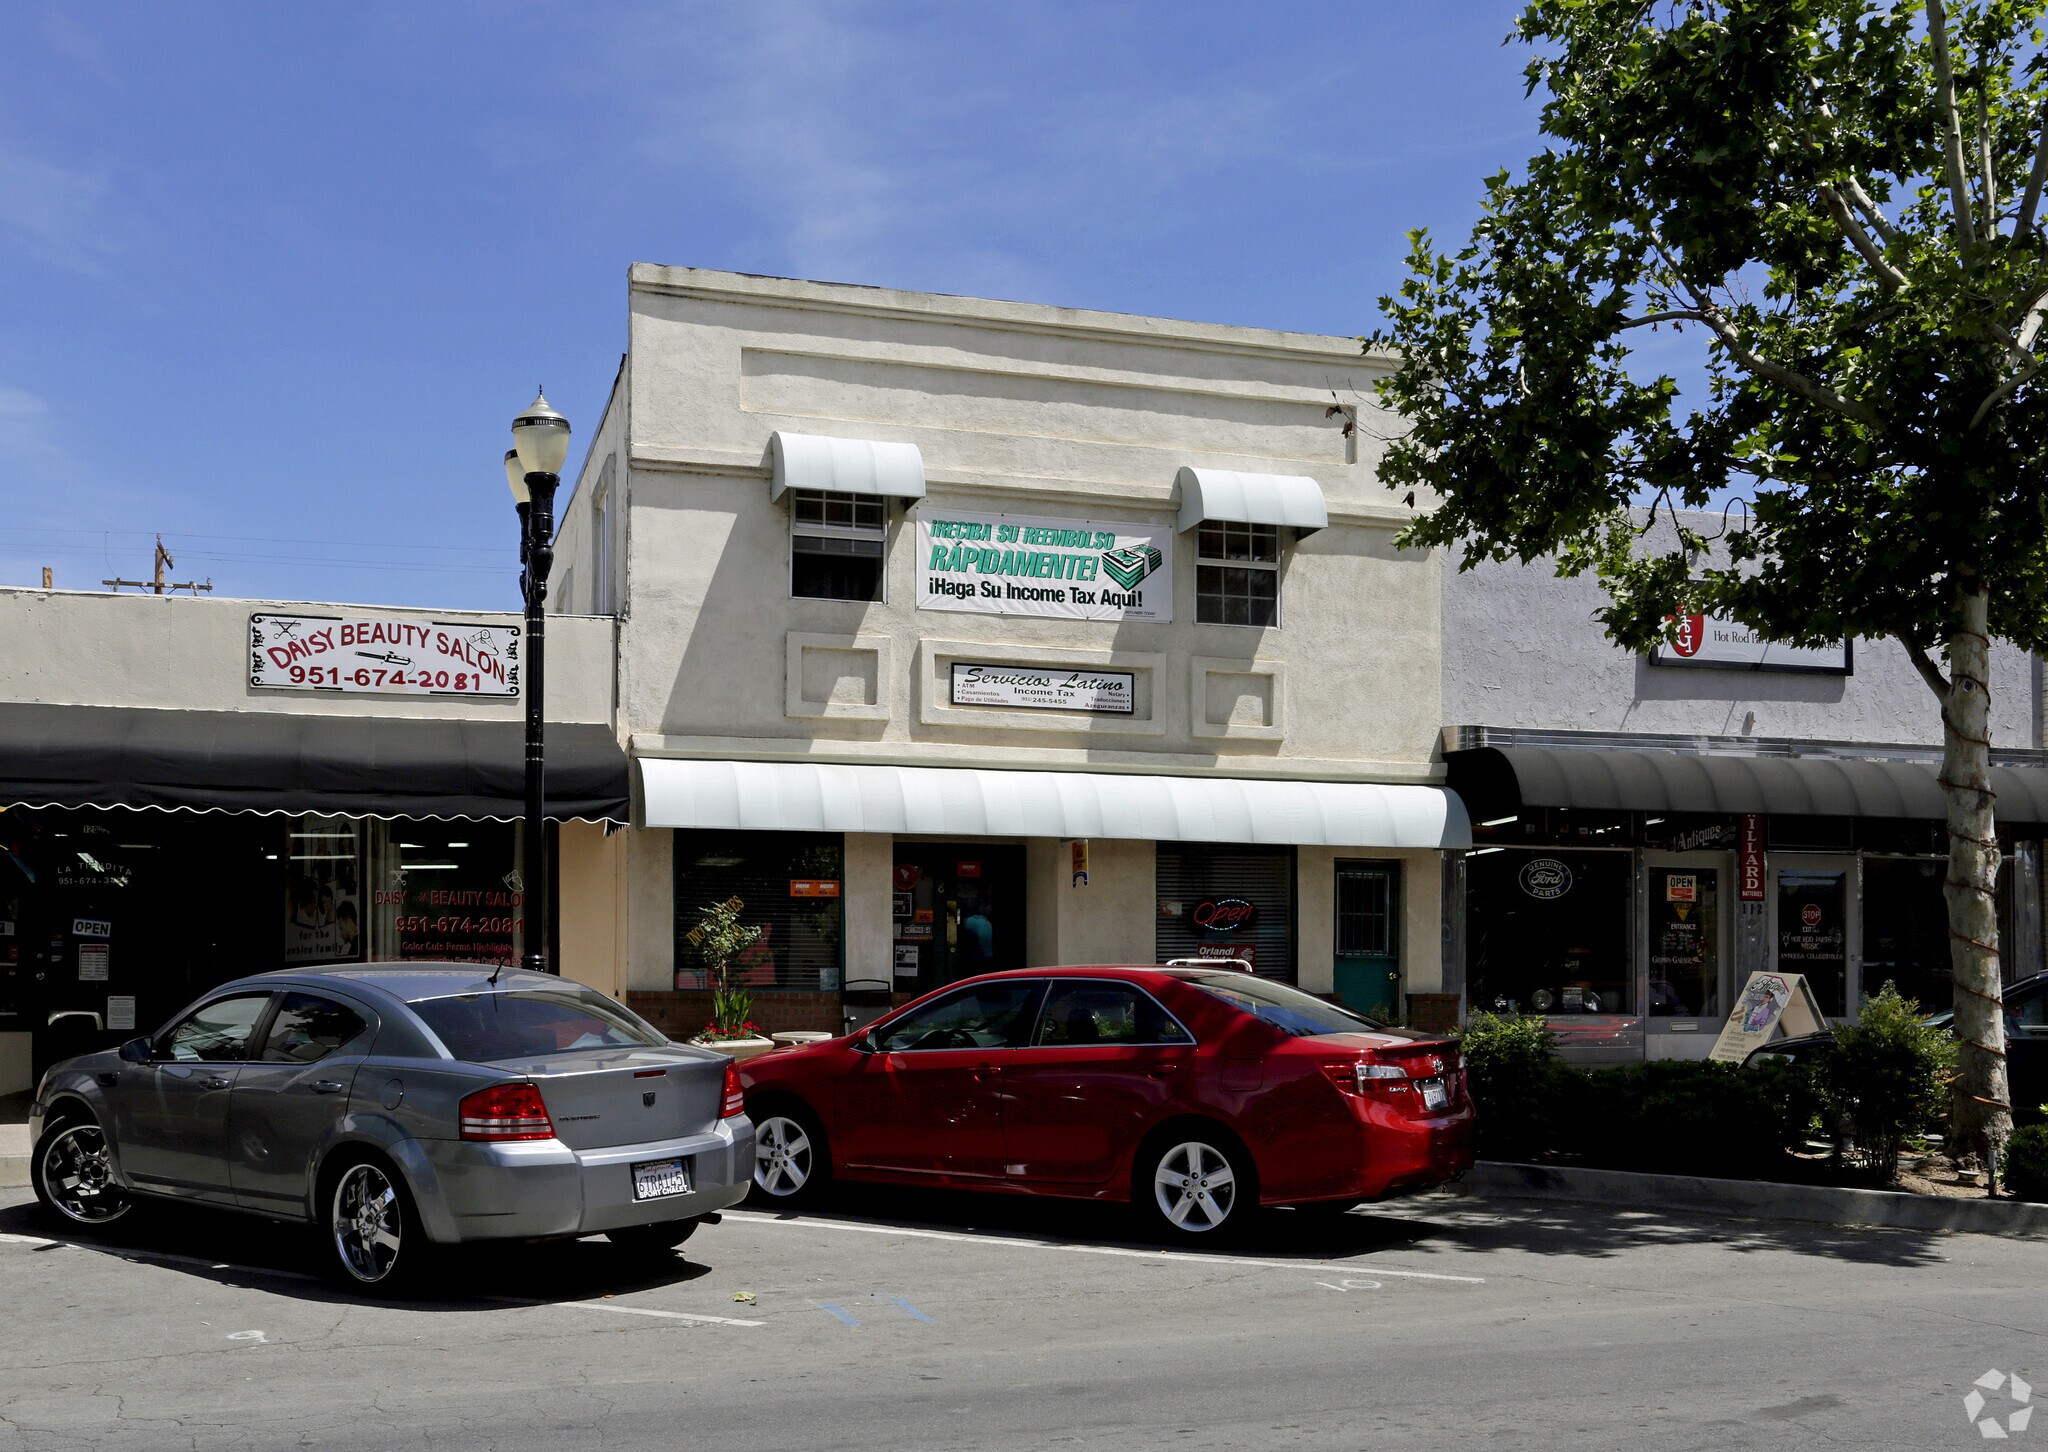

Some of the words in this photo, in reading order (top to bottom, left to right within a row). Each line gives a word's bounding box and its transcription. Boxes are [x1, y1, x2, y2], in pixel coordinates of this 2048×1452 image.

[929, 519, 991, 541] ¡RECIBA
[999, 525, 1018, 543] SU
[1023, 527, 1116, 551] REEMBOLSO
[928, 542, 1099, 581] RÁPIDAMENTE!
[928, 577, 975, 599] ¡Haga
[980, 581, 1001, 599] Su
[1006, 583, 1065, 604] Income
[1069, 587, 1095, 605] Tax
[1100, 590, 1143, 610] Aqui!
[1713, 630, 1730, 642] Hot
[1732, 631, 1750, 644] Rod
[266, 626, 335, 670] DAISY
[340, 623, 431, 648] BEAUTY
[436, 632, 505, 685] SALON
[289, 665, 481, 691] 951-674-2081
[964, 667, 1053, 688] Servicios
[1059, 673, 1125, 692] Latino
[961, 689, 1000, 697] Casamientos
[1014, 686, 1053, 697] Income
[1056, 689, 1075, 698] Tax
[1091, 696, 1126, 704] Traducciones
[1677, 825, 1721, 850] Antiques
[1745, 814, 1760, 890] ILLARD
[57, 866, 72, 874] LA
[1527, 861, 1564, 871] GENUINE
[58, 876, 130, 886] 951-674-3
[1530, 871, 1562, 885] Ford
[1670, 877, 1692, 888] OPEN
[374, 889, 408, 905] DAISY
[430, 890, 483, 907] BEAUTY
[1532, 887, 1562, 897] PARTS
[1193, 901, 1256, 926] Open
[1803, 910, 1821, 920] STOP
[75, 920, 110, 936] OPEN
[396, 916, 524, 935] 951-674-2081
[402, 941, 425, 951] Color
[425, 941, 444, 951] Cuts
[446, 942, 470, 952] Perms
[473, 942, 513, 955] Highlights
[1198, 946, 1236, 956] Orlandi
[638, 1170, 683, 1193] 6TRA145
[639, 1189, 662, 1199] SPORT
[662, 1184, 688, 1195] CHALET
